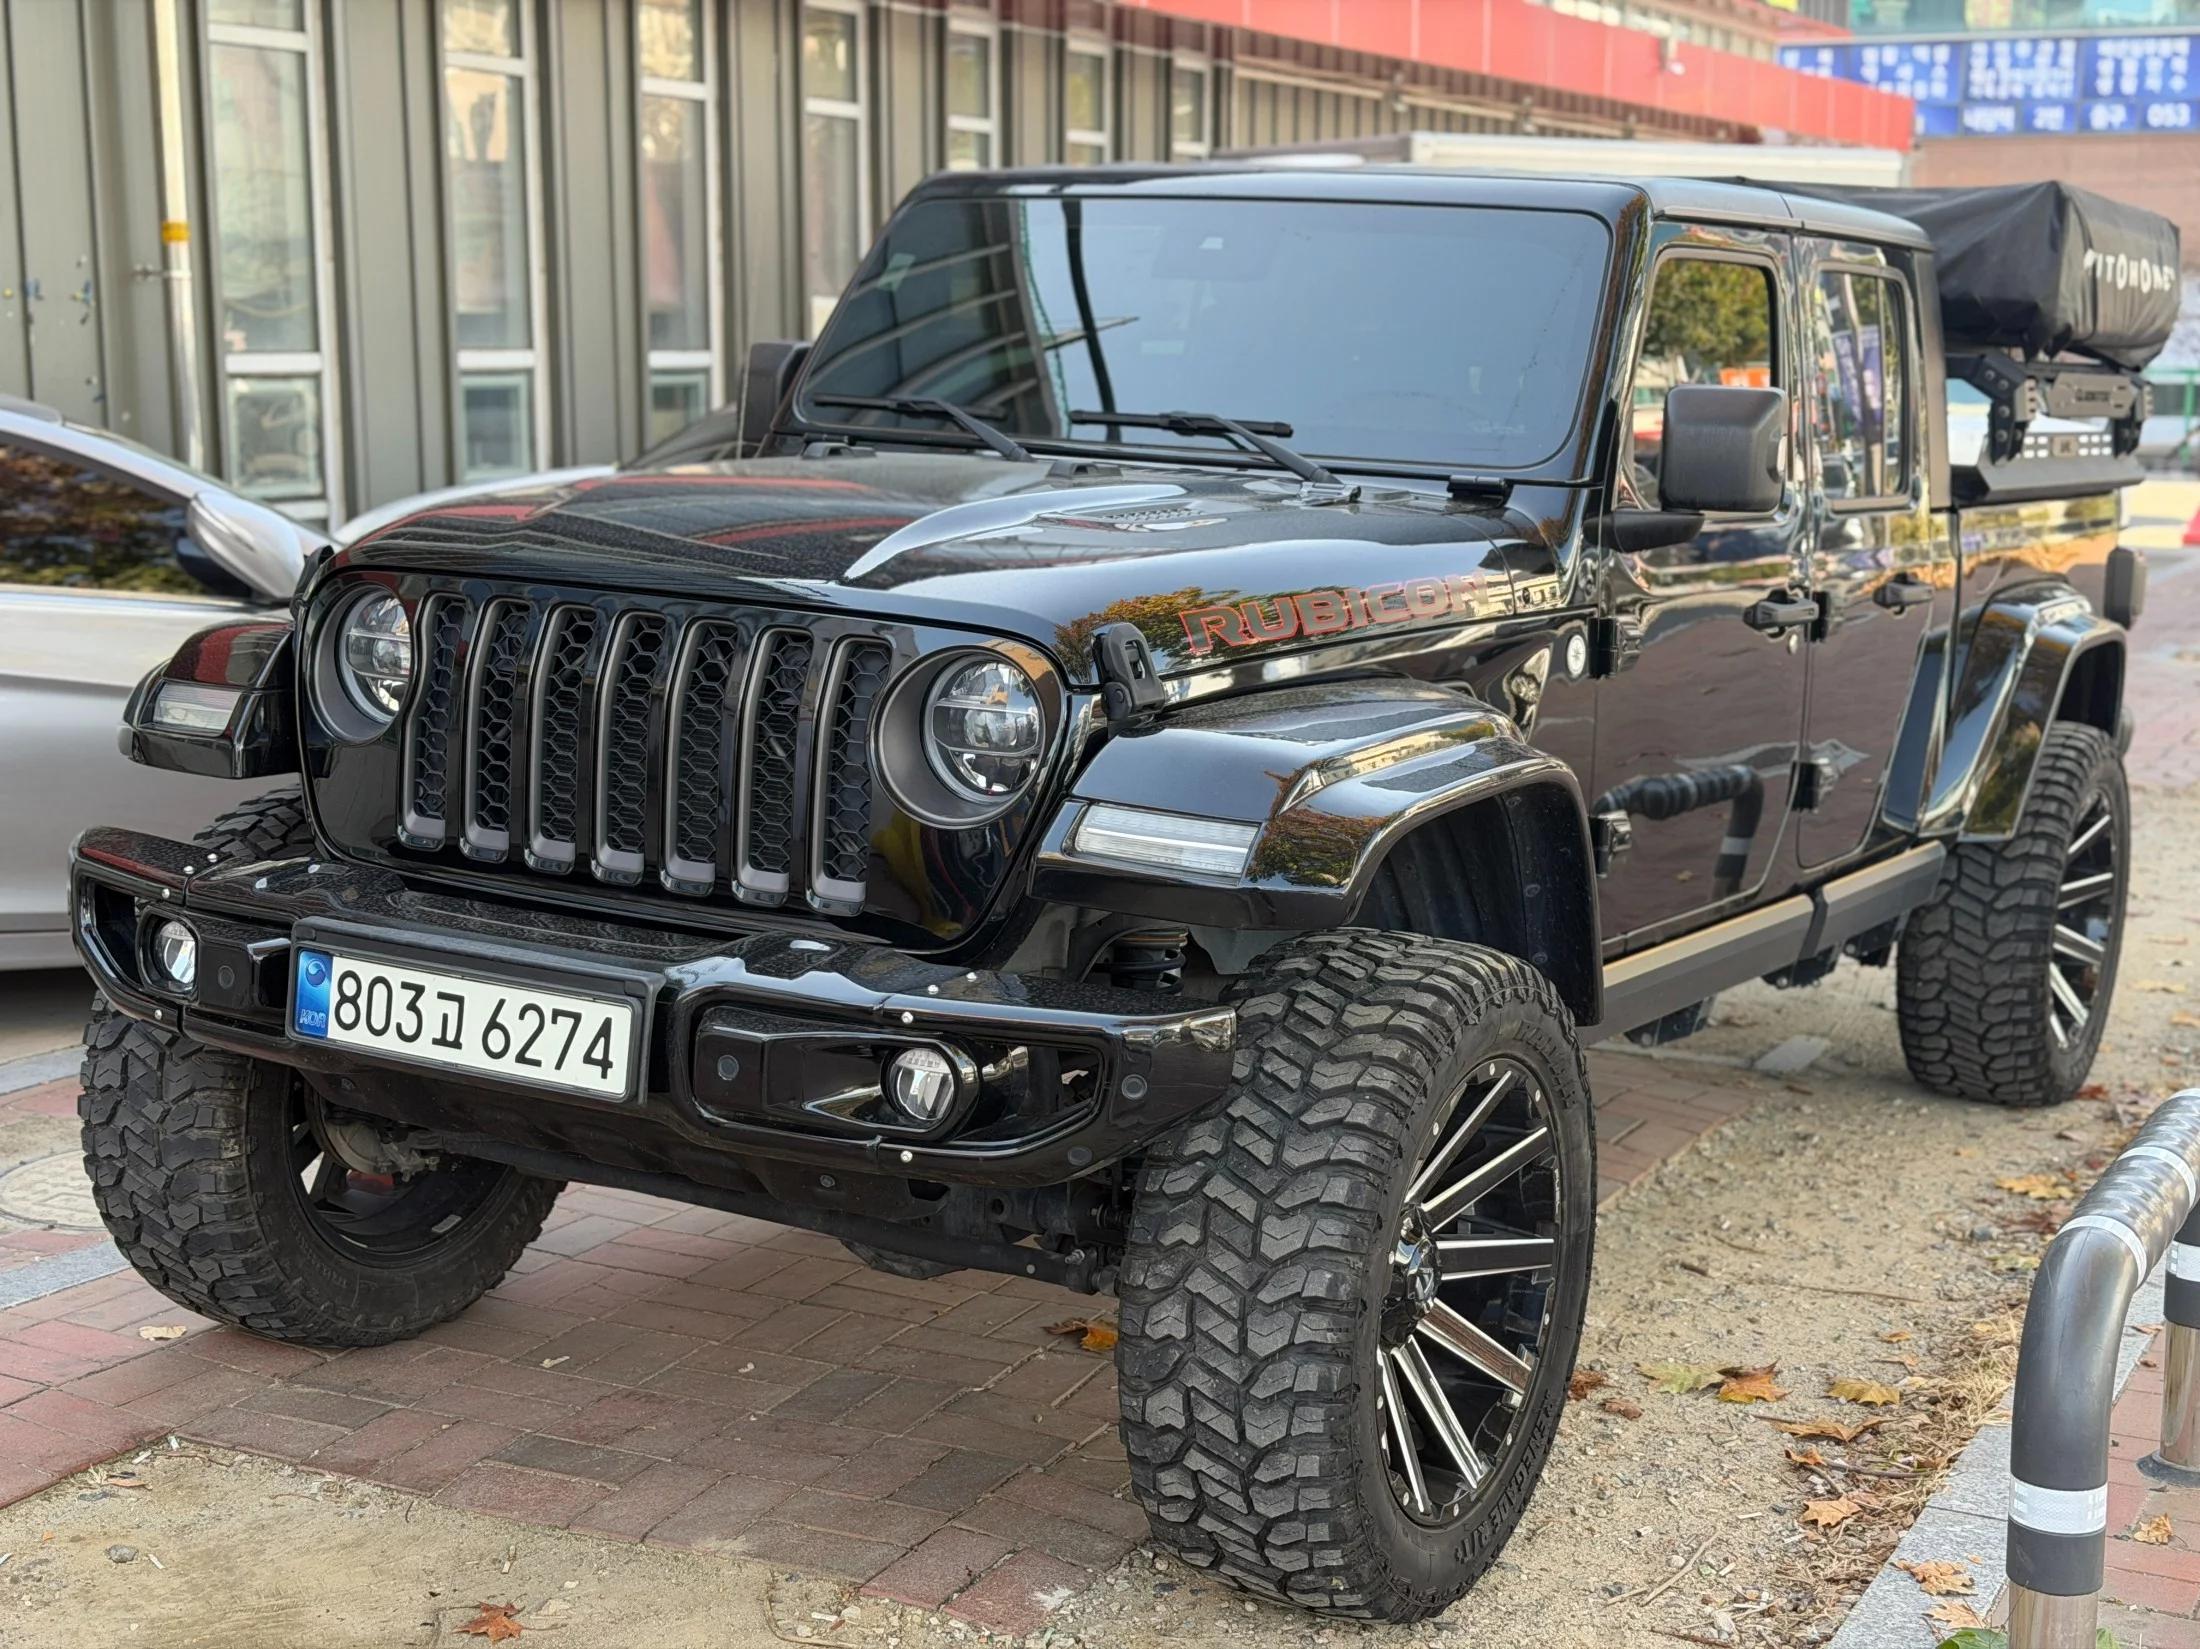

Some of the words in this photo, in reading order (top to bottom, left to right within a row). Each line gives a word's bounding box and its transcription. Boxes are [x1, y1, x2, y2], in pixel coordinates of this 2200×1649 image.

[1178, 572, 1489, 655] RUBICON
[299, 1008, 327, 1029] KOR
[335, 970, 465, 1051] 803고
[481, 997, 614, 1080] 6274
